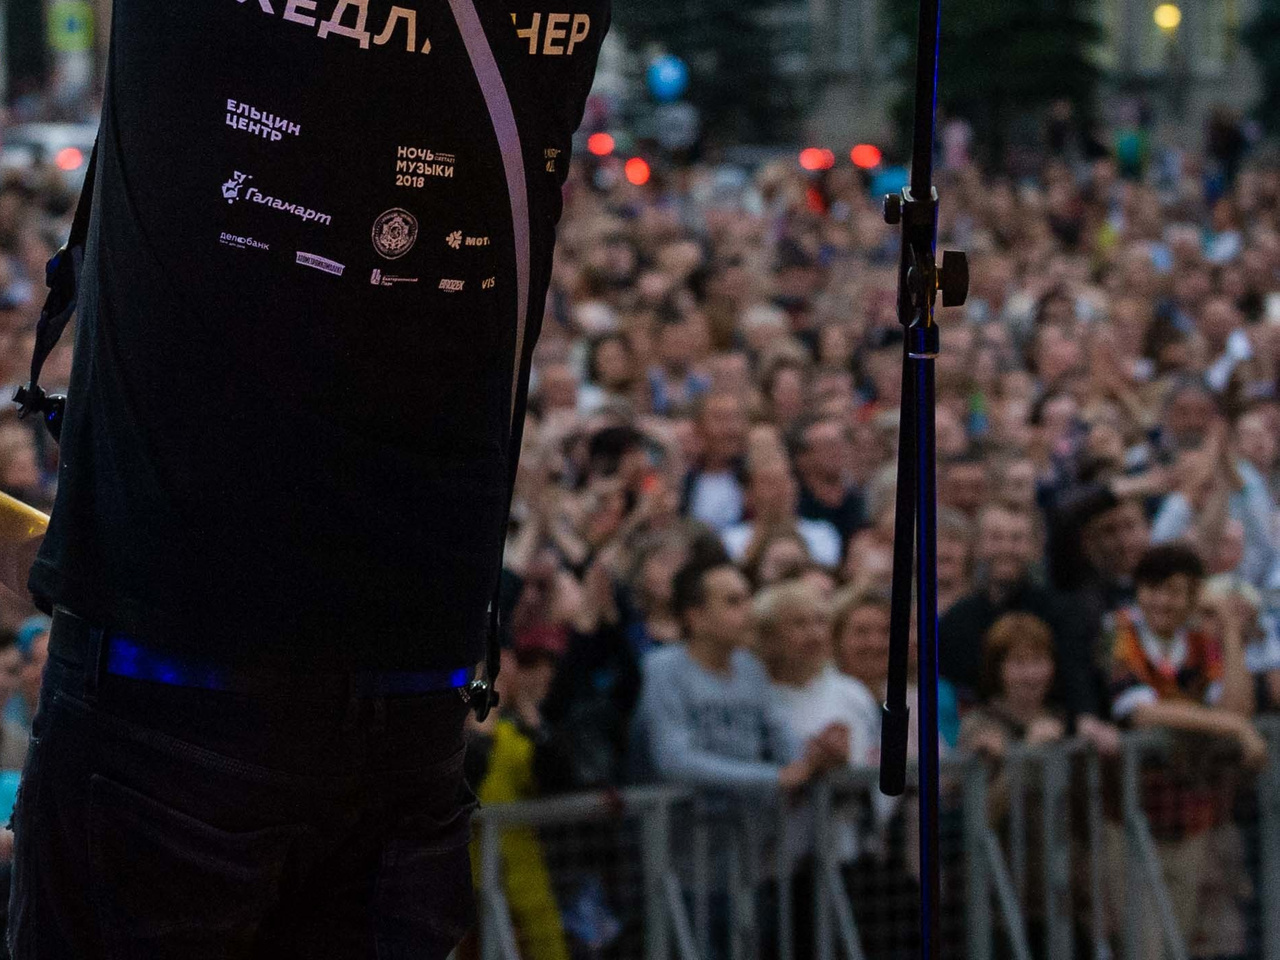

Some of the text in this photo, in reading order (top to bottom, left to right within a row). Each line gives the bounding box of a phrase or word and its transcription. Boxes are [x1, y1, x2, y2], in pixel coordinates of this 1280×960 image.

[225, 113, 283, 142] ЦЕНТР
[226, 98, 301, 136] ЕЛЬЦИН
[397, 145, 435, 161] НОЧЬ
[396, 160, 455, 178] МУЗЫКИ
[395, 174, 425, 188] 2018
[245, 187, 332, 226] Галамарт
